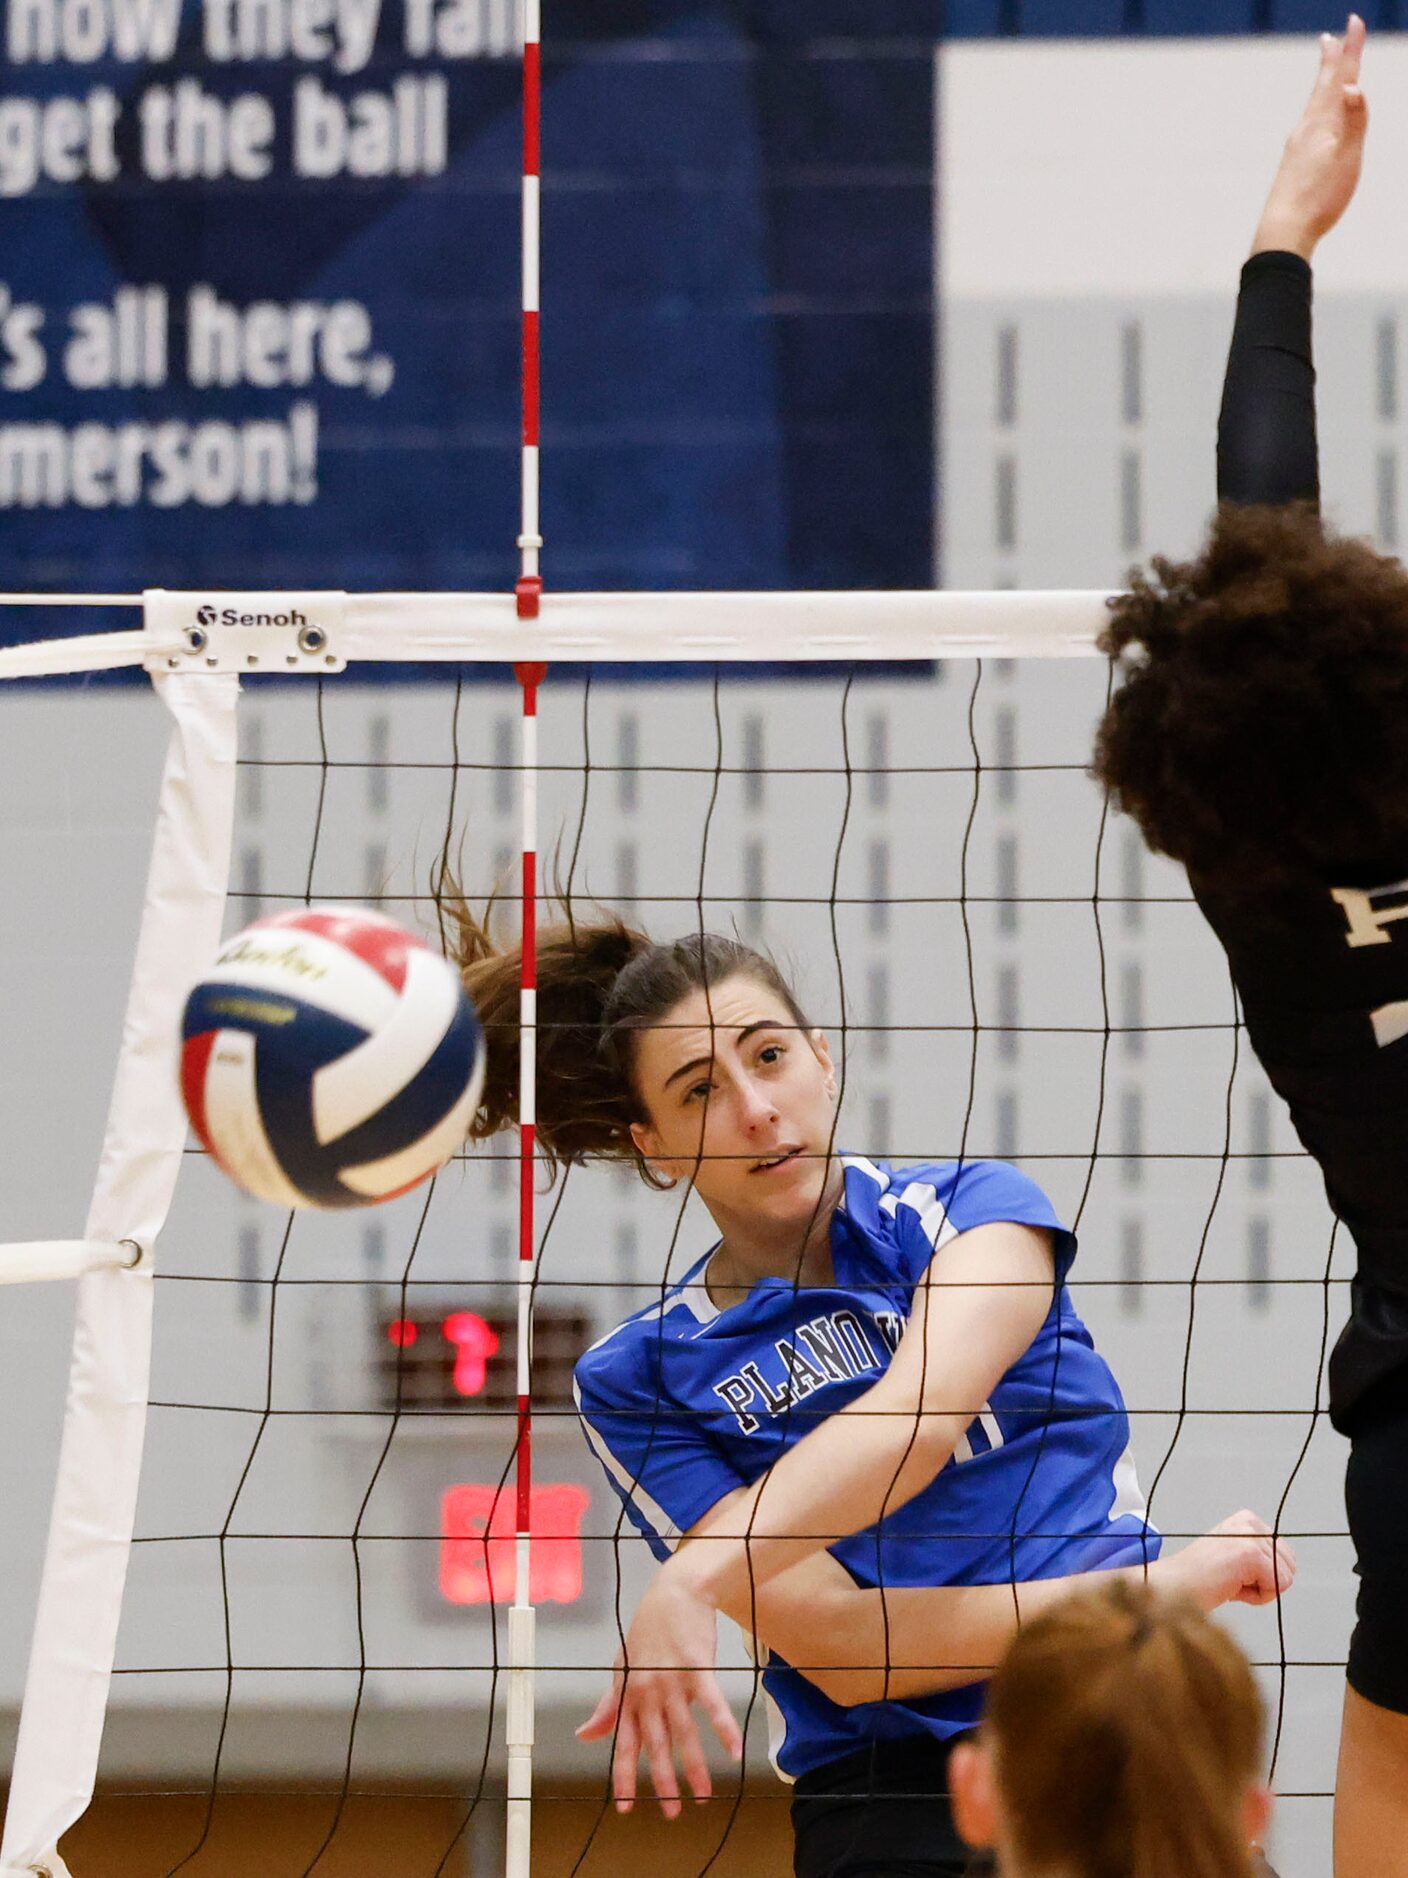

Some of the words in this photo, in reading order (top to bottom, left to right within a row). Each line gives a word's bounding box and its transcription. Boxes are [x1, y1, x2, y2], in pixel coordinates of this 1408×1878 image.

[204, 0, 380, 73] they
[0, 86, 120, 196] get
[142, 79, 273, 178] the
[295, 74, 446, 177] ball
[63, 290, 166, 387] all
[190, 289, 392, 397] here,
[0, 405, 316, 506] merson!
[222, 610, 306, 626] Senoh
[714, 1310, 881, 1435] PLANO
